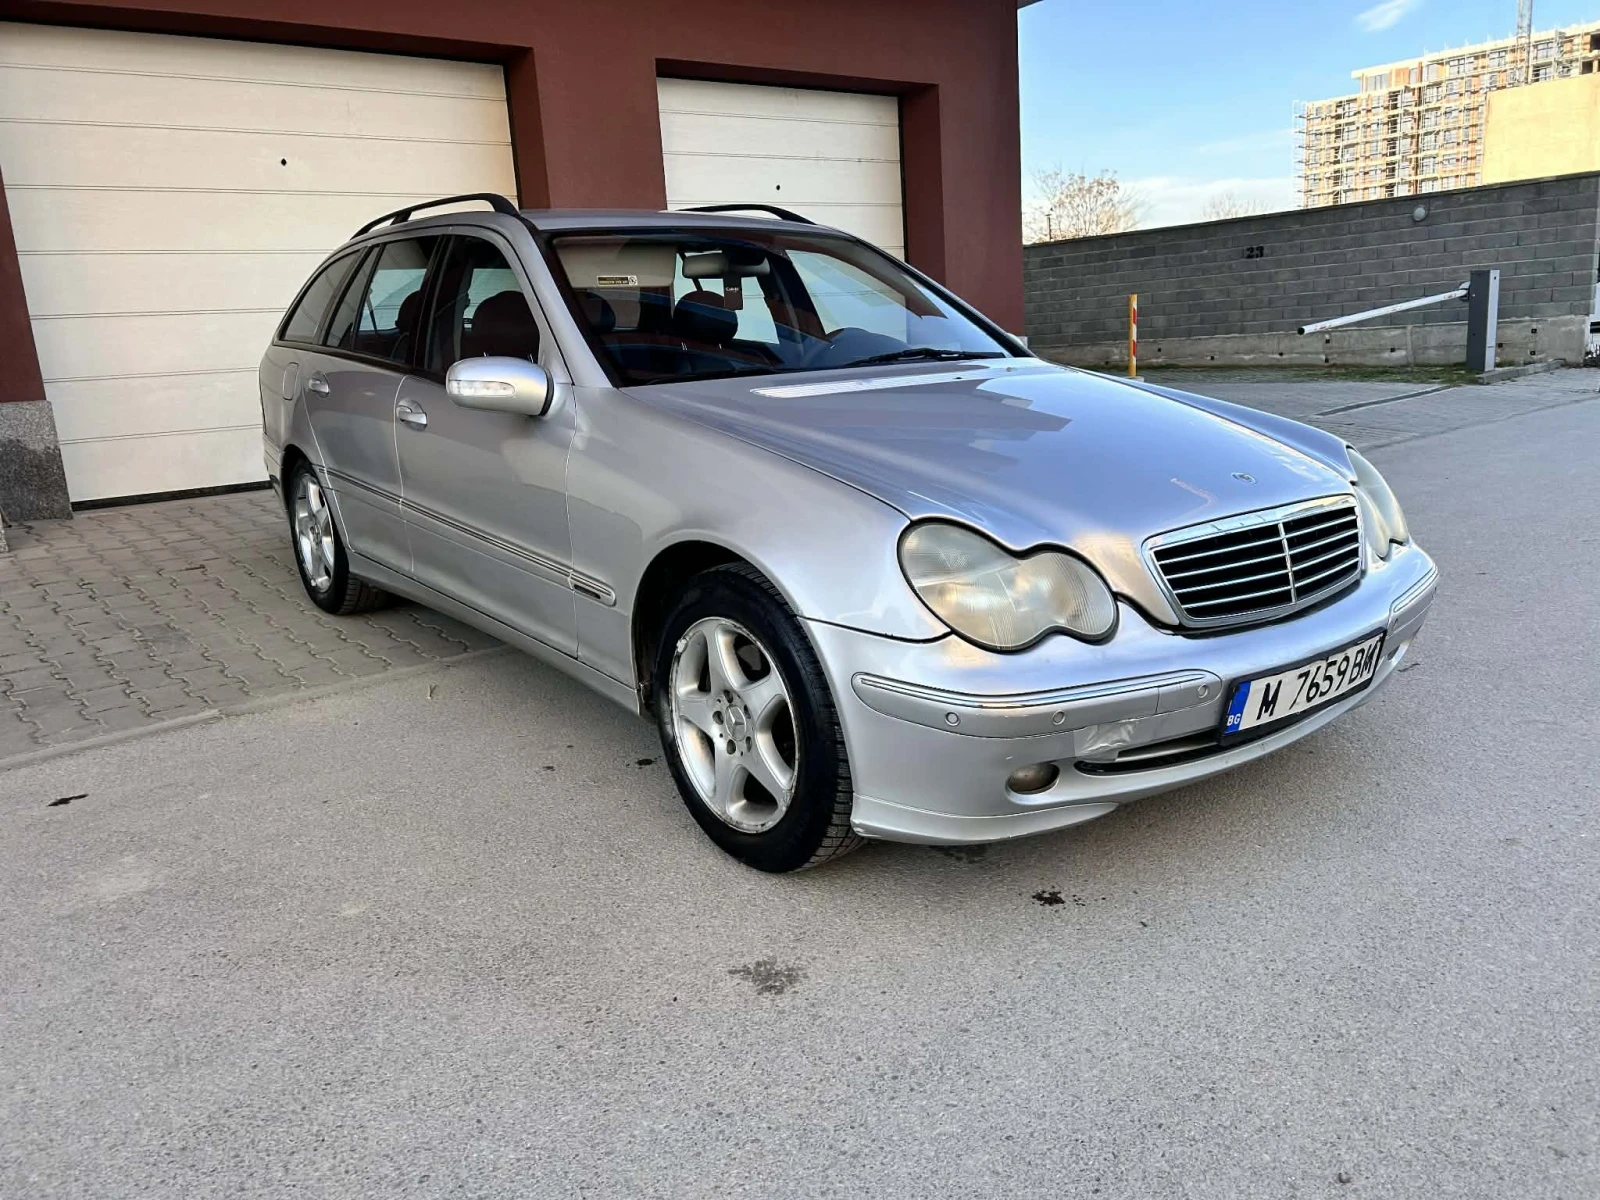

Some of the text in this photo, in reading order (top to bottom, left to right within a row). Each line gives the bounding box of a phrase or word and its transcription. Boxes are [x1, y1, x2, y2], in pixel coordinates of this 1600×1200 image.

[1246, 246, 1264, 259] 23
[1256, 679, 1283, 721] M
[1227, 713, 1242, 727] BG
